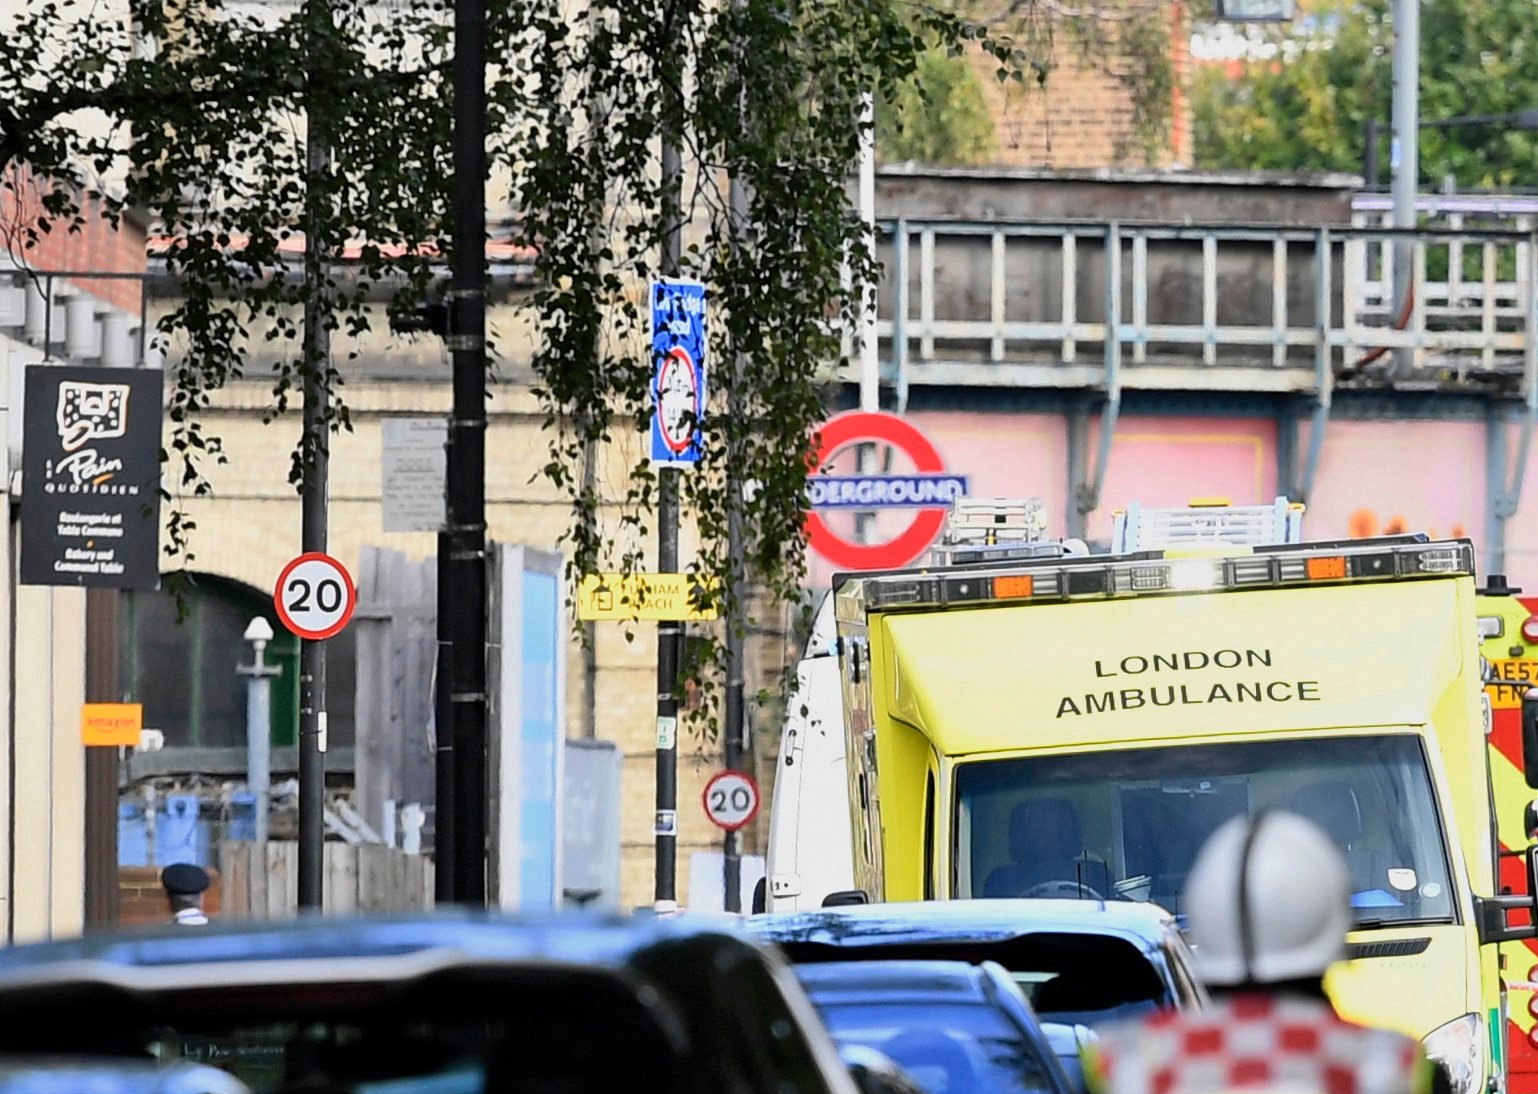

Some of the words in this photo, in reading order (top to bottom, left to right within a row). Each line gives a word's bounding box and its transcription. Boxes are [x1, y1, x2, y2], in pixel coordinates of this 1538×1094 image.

[55, 448, 123, 485] Pain
[44, 482, 139, 495] QUOTIDIEN
[806, 479, 963, 505] DERGROUND
[65, 548, 96, 562] Bakery
[97, 549, 115, 560] and
[54, 560, 100, 573] Communal
[288, 579, 342, 612] 20
[621, 583, 679, 595] UHAM
[628, 599, 674, 609] RACH
[1095, 649, 1272, 678] LONDON
[1056, 681, 1322, 718] AMBULANCE
[1496, 685, 1525, 702] FN
[711, 786, 750, 812] 20
